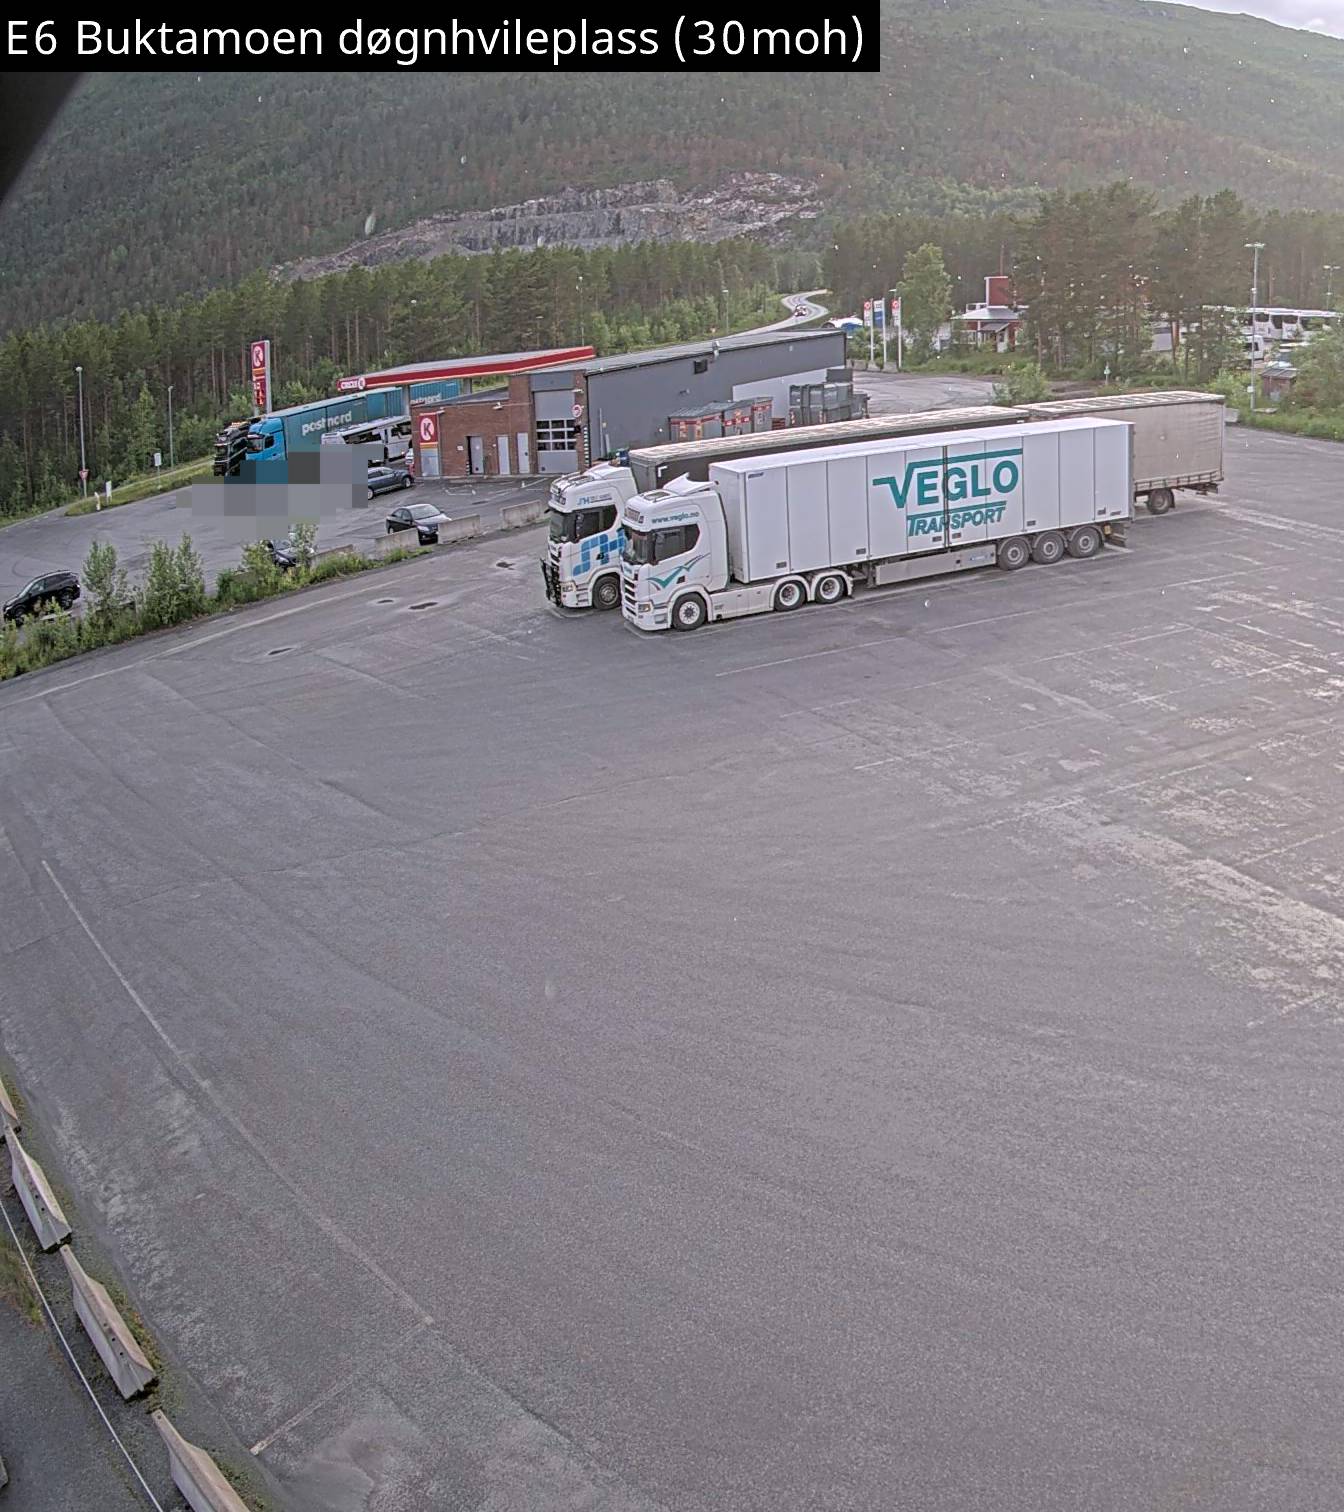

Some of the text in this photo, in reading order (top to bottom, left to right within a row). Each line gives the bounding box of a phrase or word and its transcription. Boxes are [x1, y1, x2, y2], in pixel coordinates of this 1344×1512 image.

[302, 410, 352, 436] postnord
[876, 453, 1020, 509] VEGLO
[650, 511, 700, 524] www.veglo.no
[907, 503, 1006, 537] TRANSPORT
